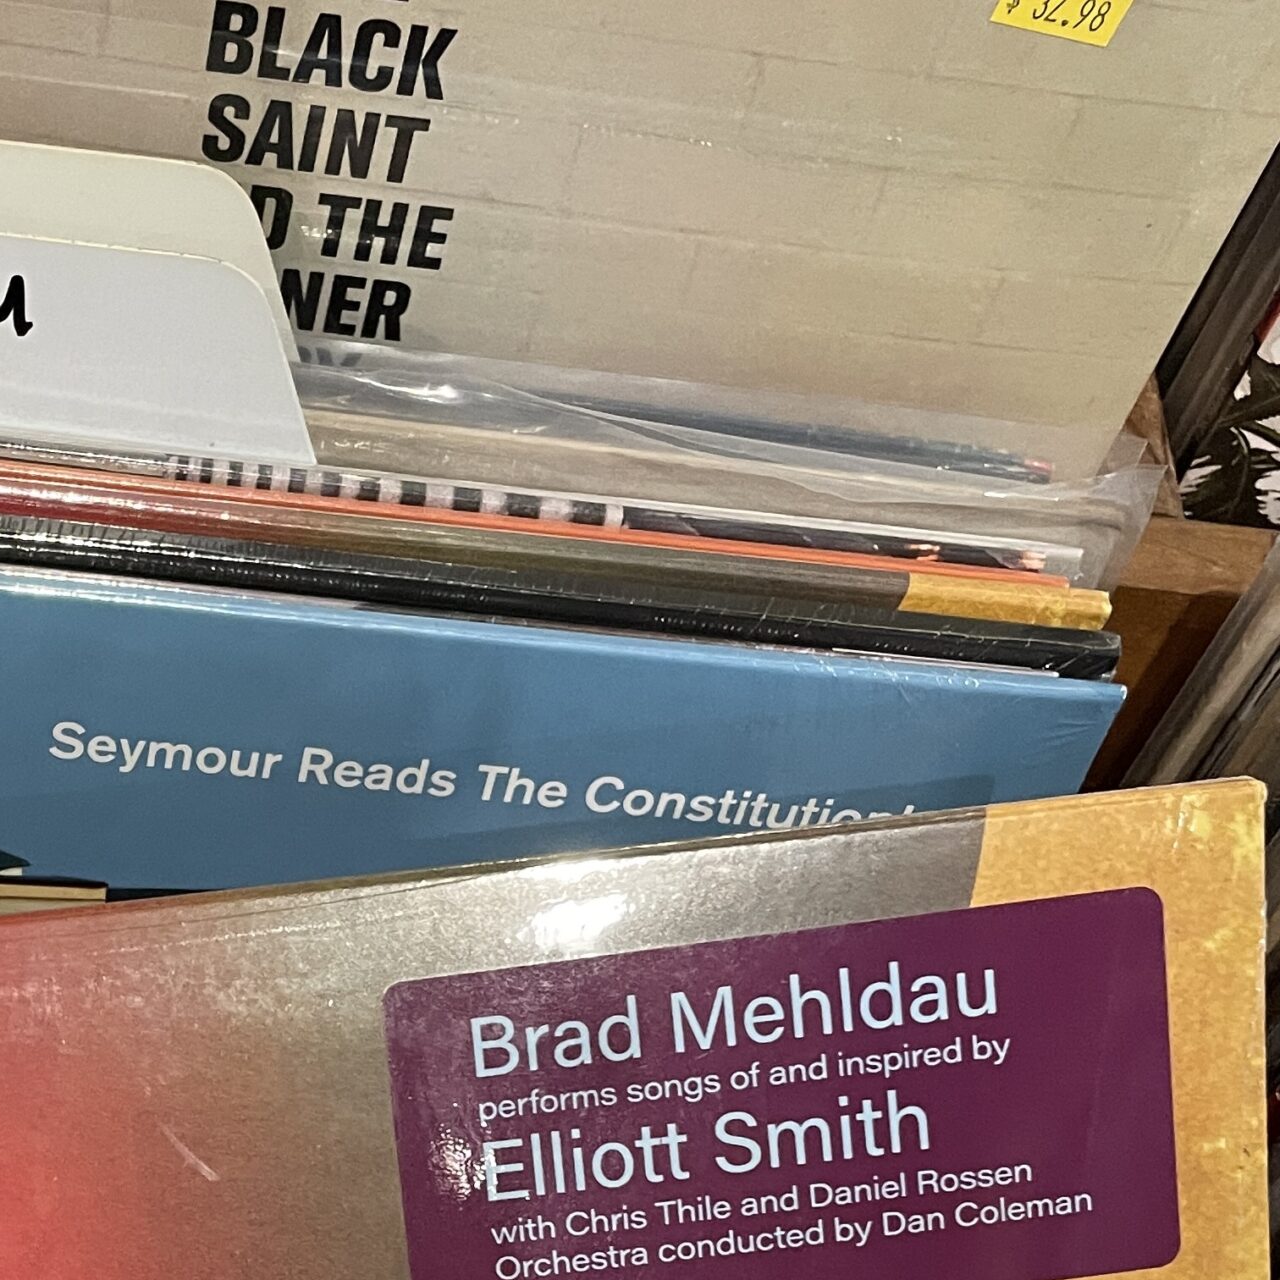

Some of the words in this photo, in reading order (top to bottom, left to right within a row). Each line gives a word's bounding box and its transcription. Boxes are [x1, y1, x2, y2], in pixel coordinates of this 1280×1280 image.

[205, 0, 458, 100] BLACK
[202, 93, 431, 183] SAINT
[318, 192, 455, 271] THE
[49, 721, 283, 773] Seymour
[297, 746, 457, 798] Reads
[477, 763, 568, 808] The
[469, 994, 643, 1079] Brad
[669, 961, 998, 1054] Mehldau
[478, 1082, 618, 1124] performs
[626, 1074, 721, 1104] songs
[729, 1061, 762, 1090] of
[768, 1053, 829, 1085] and
[837, 1036, 963, 1079] inspired
[971, 1034, 1012, 1065] by
[485, 1122, 691, 1203] Elliott
[713, 1089, 931, 1175] Smith
[490, 1216, 557, 1246] with
[564, 1205, 648, 1239] Chris
[654, 1195, 733, 1228] Thile
[740, 1188, 801, 1217] and
[809, 1172, 907, 1208] Daniel
[916, 1161, 1034, 1194] Rossen
[494, 1243, 650, 1280] Orchestra
[657, 1219, 825, 1263] conducted
[833, 1214, 874, 1247] by
[881, 1207, 947, 1238] Dan
[953, 1190, 1094, 1229] Coleman
